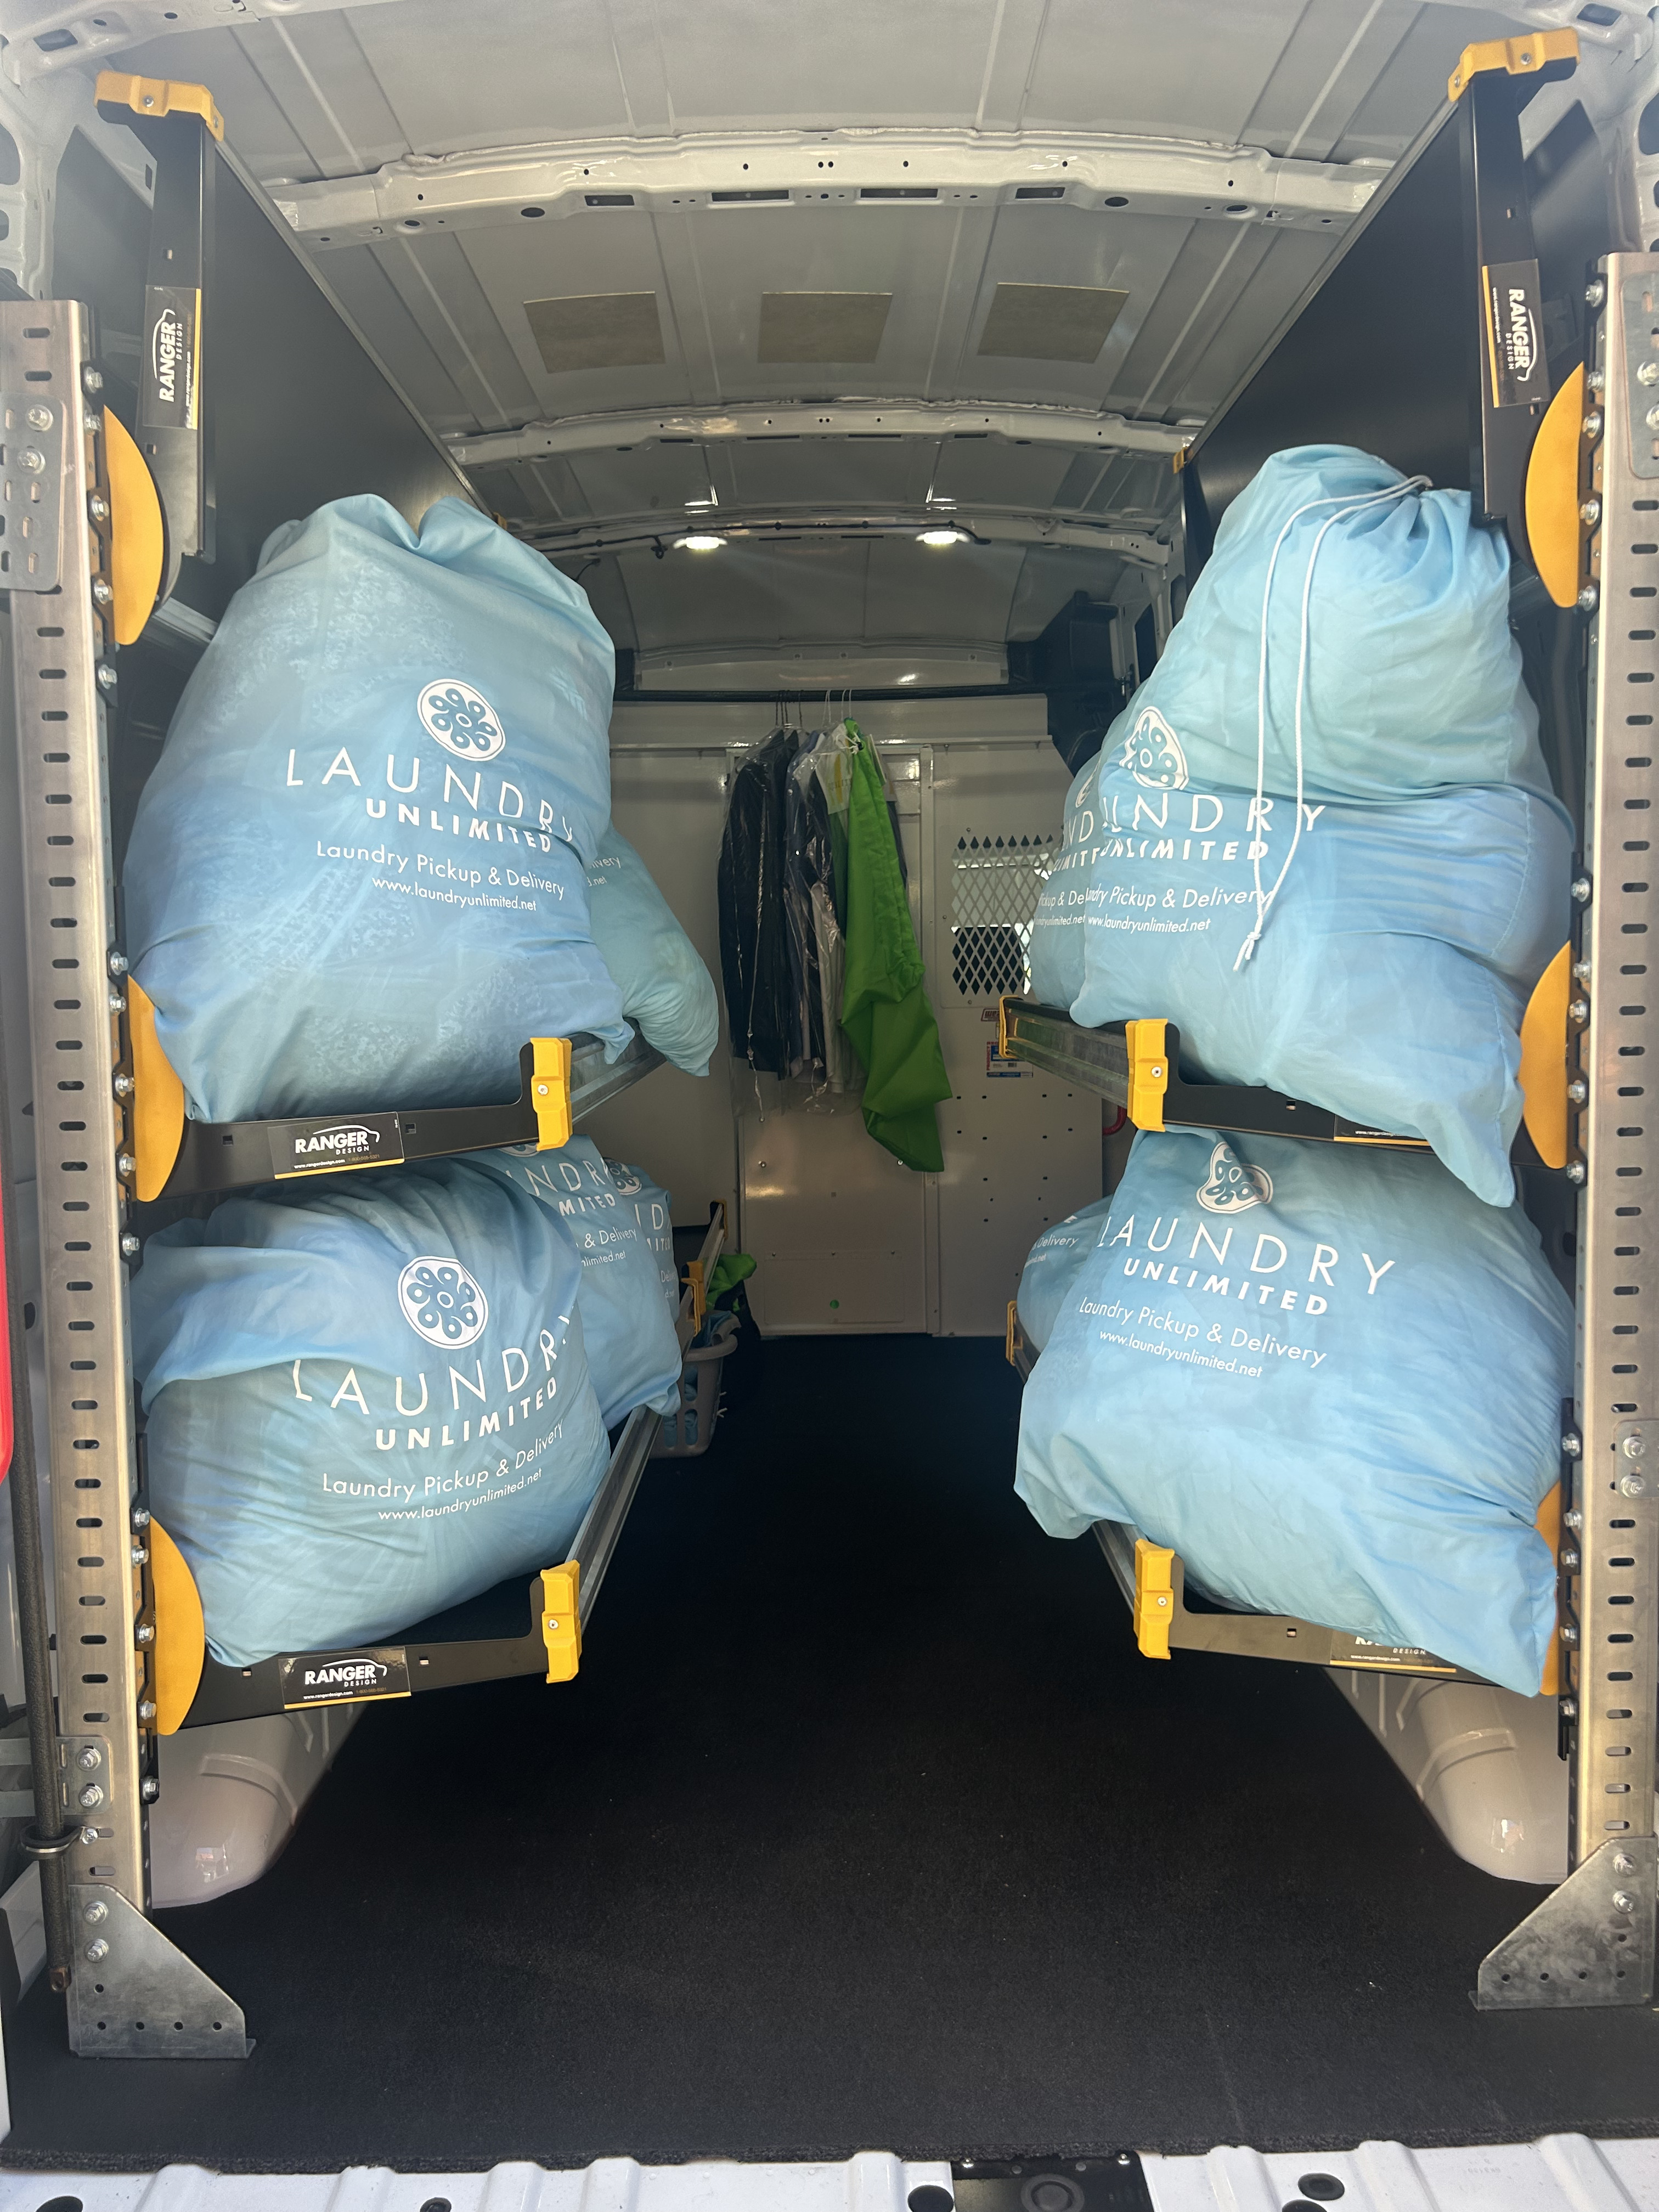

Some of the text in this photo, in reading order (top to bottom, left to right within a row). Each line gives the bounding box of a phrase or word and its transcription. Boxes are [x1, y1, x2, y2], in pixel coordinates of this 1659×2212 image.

[1509, 289, 1530, 369] RANGER
[159, 321, 176, 403] RANGER
[1505, 332, 1514, 370] DESIGN
[366, 798, 551, 853] UNLIMITED
[1102, 792, 1325, 833] UNDRY
[317, 841, 565, 901] Laundry Pickup & Delivery
[371, 877, 537, 912] www.laundryunlimited.net
[1057, 891, 1065, 906] &
[1109, 885, 1156, 912] Pickup
[1162, 888, 1175, 909] &
[1182, 887, 1273, 909] Delivery
[1088, 913, 1211, 934] www.laundryunlimited.net
[295, 1131, 369, 1154] RANGER
[336, 1145, 369, 1155] DESIGN
[506, 1156, 613, 1197] NDRY
[558, 1193, 616, 1217] MITED
[584, 1233, 596, 1249] &
[599, 1226, 637, 1245] Delivery
[1097, 1214, 1396, 1295] LAUNDRY
[1123, 1257, 1328, 1316] UNLIMITED
[1079, 1295, 1328, 1369] Laundry Pickup & Delivery
[1099, 1329, 1263, 1378] www.laundryunlimited.net
[376, 1375, 557, 1451] UNLIMITED
[323, 1419, 563, 1503] Laundry Pickup & Delivery
[378, 1468, 543, 1520] www.laundryunlimited.net
[304, 1664, 376, 1685] RANGER
[343, 1679, 377, 1688] DESIGN
